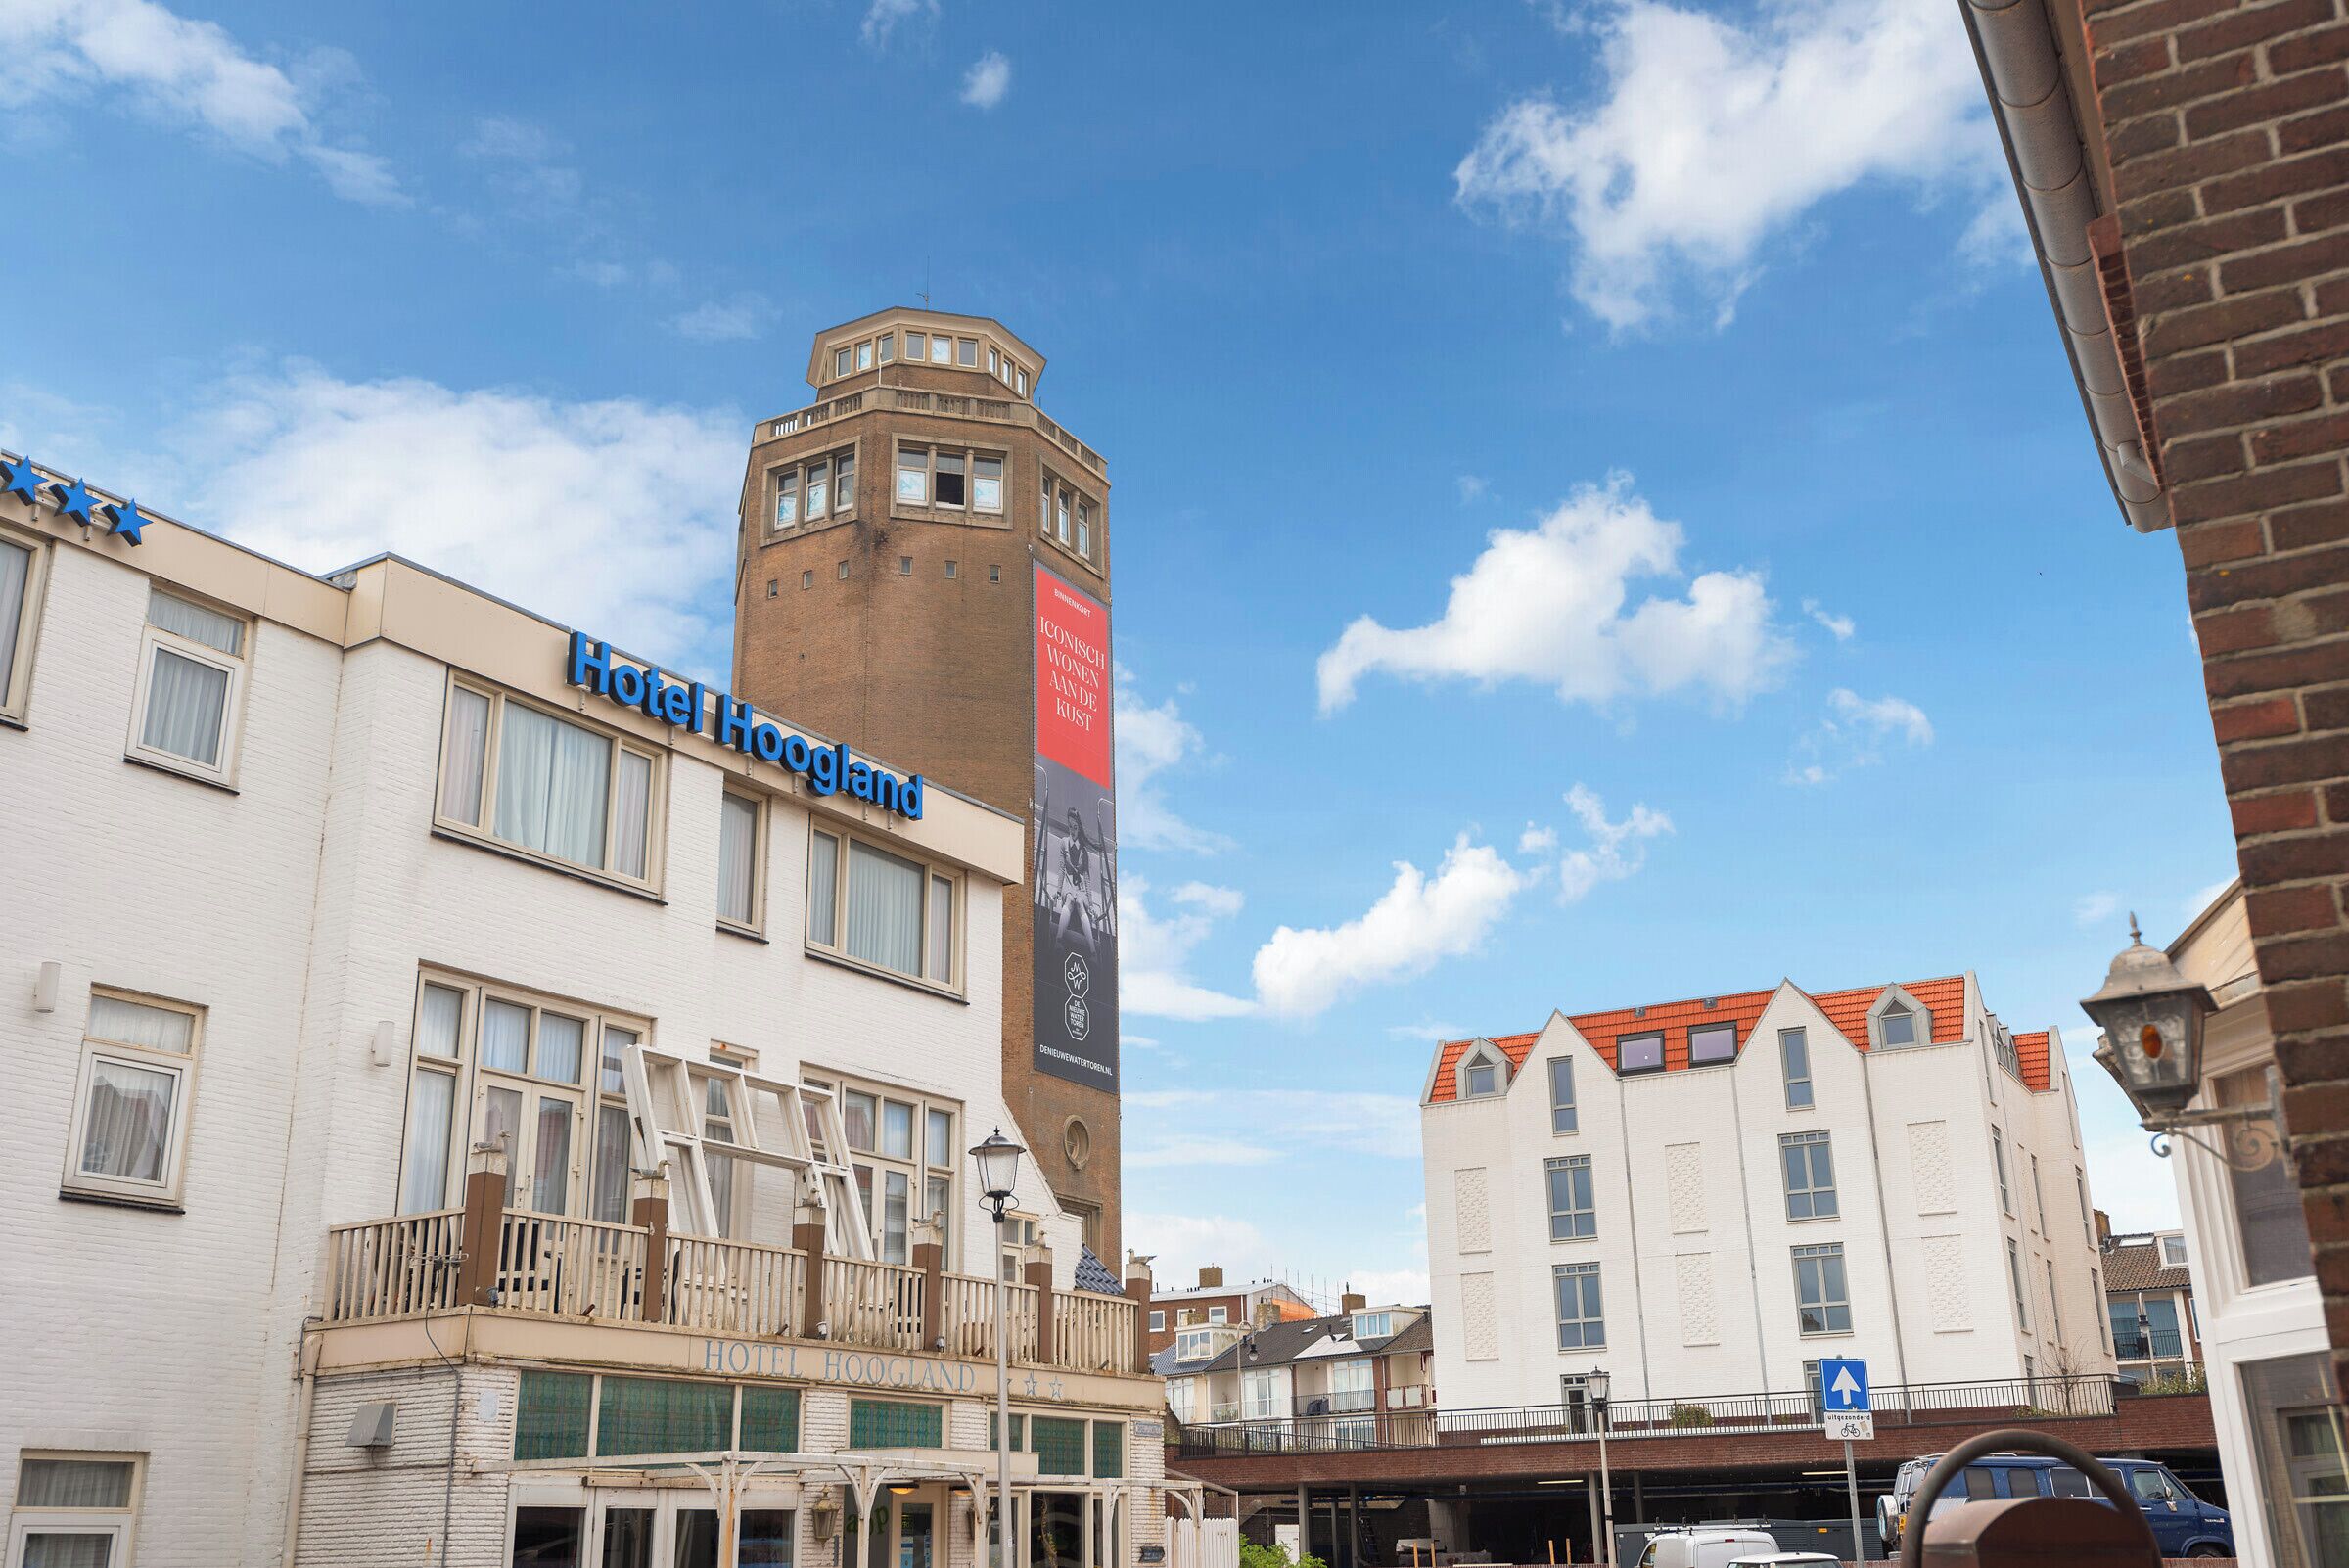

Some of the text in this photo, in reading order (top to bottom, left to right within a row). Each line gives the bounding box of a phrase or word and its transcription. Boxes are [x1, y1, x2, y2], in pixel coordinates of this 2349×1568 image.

[1054, 588, 1091, 618] BINNENKORT
[1039, 616, 1106, 670] ICONISCH
[1046, 644, 1099, 689] WONEN
[1049, 670, 1097, 712] AAN DE
[567, 631, 923, 820] Hotel Hoogland
[1056, 697, 1092, 732] KUST
[1039, 1044, 1113, 1076] DENIEUWEWATERTOREN.NL
[704, 1340, 975, 1392] HOTEL HOOGLAND
